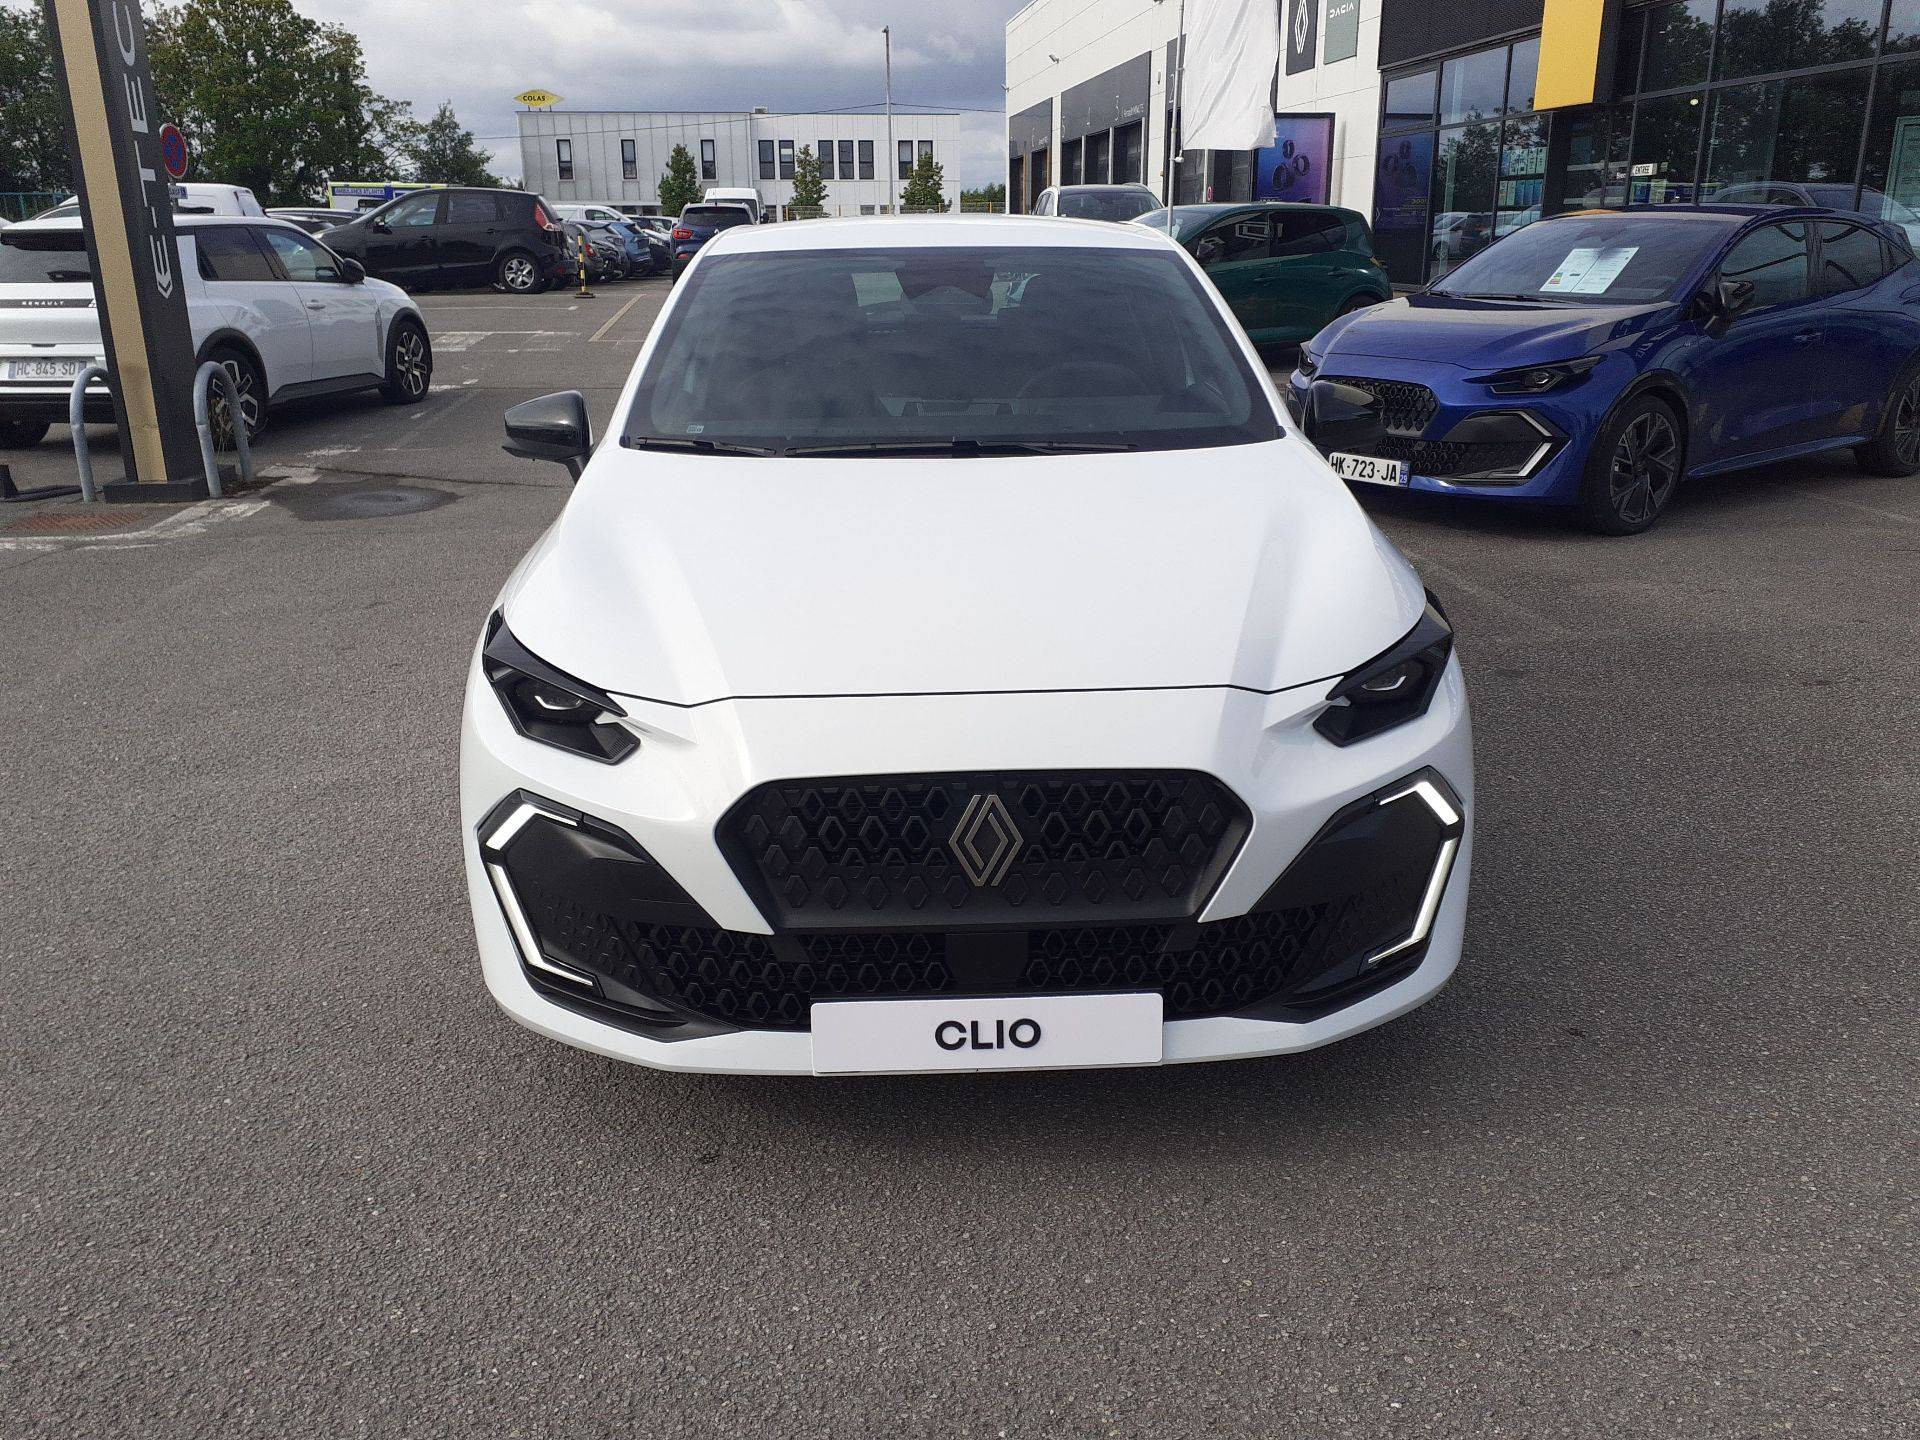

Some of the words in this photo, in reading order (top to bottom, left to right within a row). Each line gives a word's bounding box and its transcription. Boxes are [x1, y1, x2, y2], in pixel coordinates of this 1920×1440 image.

[1329, 2, 1355, 19] DACIA
[16, 361, 76, 376] HC-845-SD
[1330, 455, 1397, 483] HK-723-JA
[1400, 474, 1408, 484] 29
[934, 1018, 1042, 1051] CLIO
